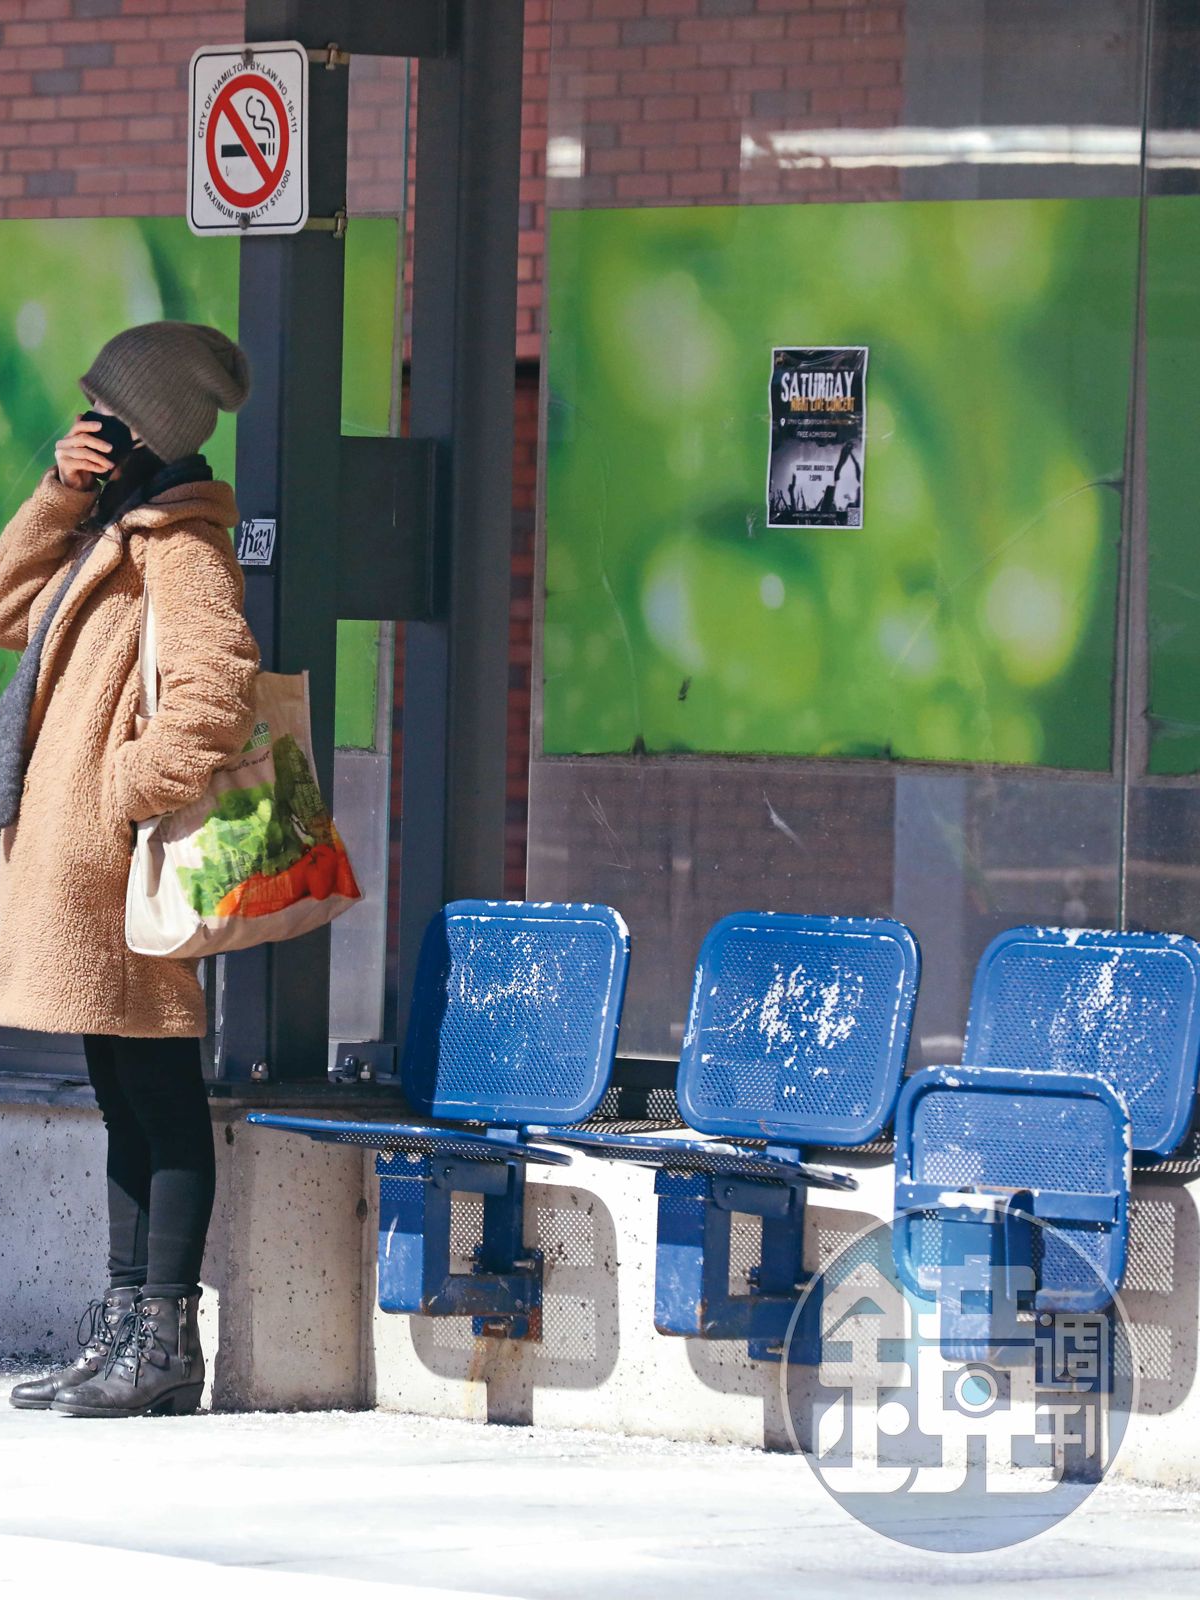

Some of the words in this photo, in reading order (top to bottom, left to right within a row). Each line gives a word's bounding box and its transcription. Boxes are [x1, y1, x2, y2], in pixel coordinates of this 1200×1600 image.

[198, 112, 208, 138] CITY
[204, 95, 213, 109] OF
[212, 61, 248, 94] HAMILTON
[249, 60, 279, 84] BY-LAW
[286, 100, 298, 133] 16-111
[203, 181, 234, 219] MAXIMUM
[780, 371, 855, 402] SATURDAY
